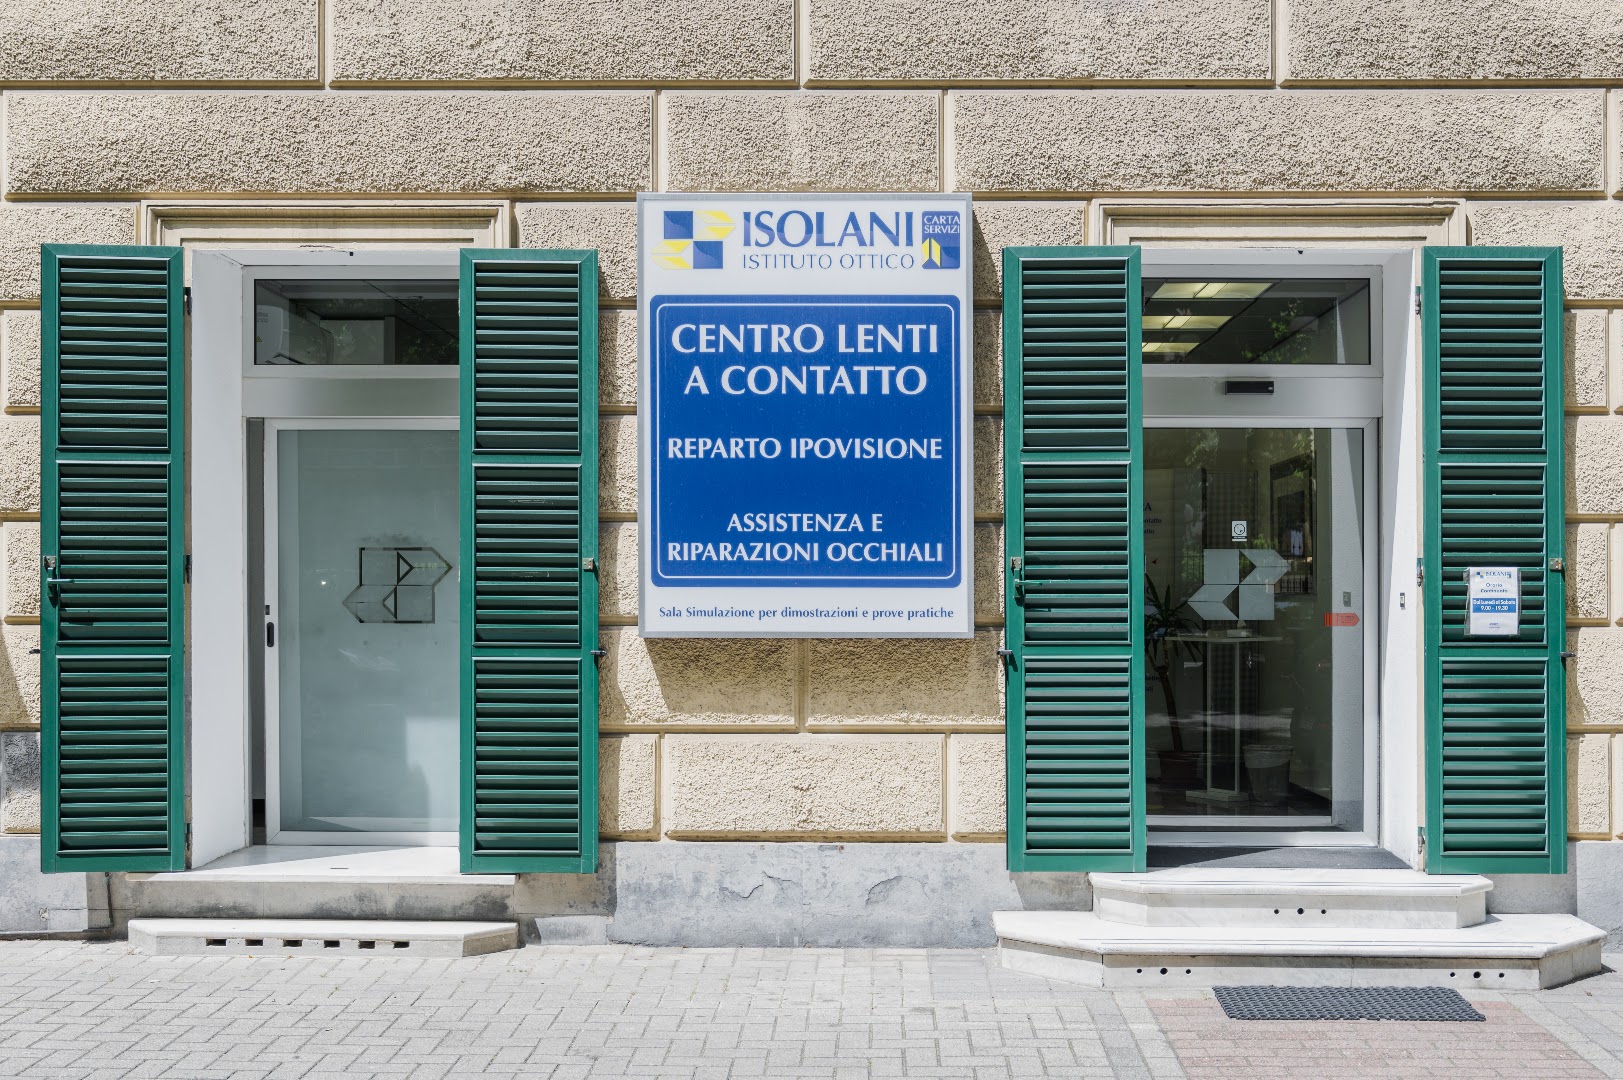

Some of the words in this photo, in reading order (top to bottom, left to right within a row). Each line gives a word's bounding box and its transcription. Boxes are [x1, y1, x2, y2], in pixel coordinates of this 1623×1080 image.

[743, 209, 914, 248] ISOLANI
[923, 215, 960, 225] CARTA
[923, 225, 960, 234] SERVIZI
[743, 253, 832, 270] ISTITUTO
[840, 253, 914, 270] OTTICO
[671, 323, 825, 353] CENTRO
[838, 324, 938, 353] LENTI
[684, 365, 710, 395] A
[721, 365, 928, 395] CONTATTO
[668, 437, 782, 459] REPARTO
[790, 437, 943, 459] IPOVISIONE
[726, 512, 864, 532] ASSISTENZA
[872, 513, 883, 532] E
[668, 542, 819, 562] RIPARAZIONI
[827, 542, 943, 562] OCCHIALI
[659, 606, 682, 618] Sala
[685, 606, 755, 618] Simulazione
[758, 609, 777, 621] per
[780, 606, 858, 618] dimostrazioni
[862, 609, 869, 618] e
[872, 609, 904, 621] prove
[907, 607, 954, 621] pratiche
